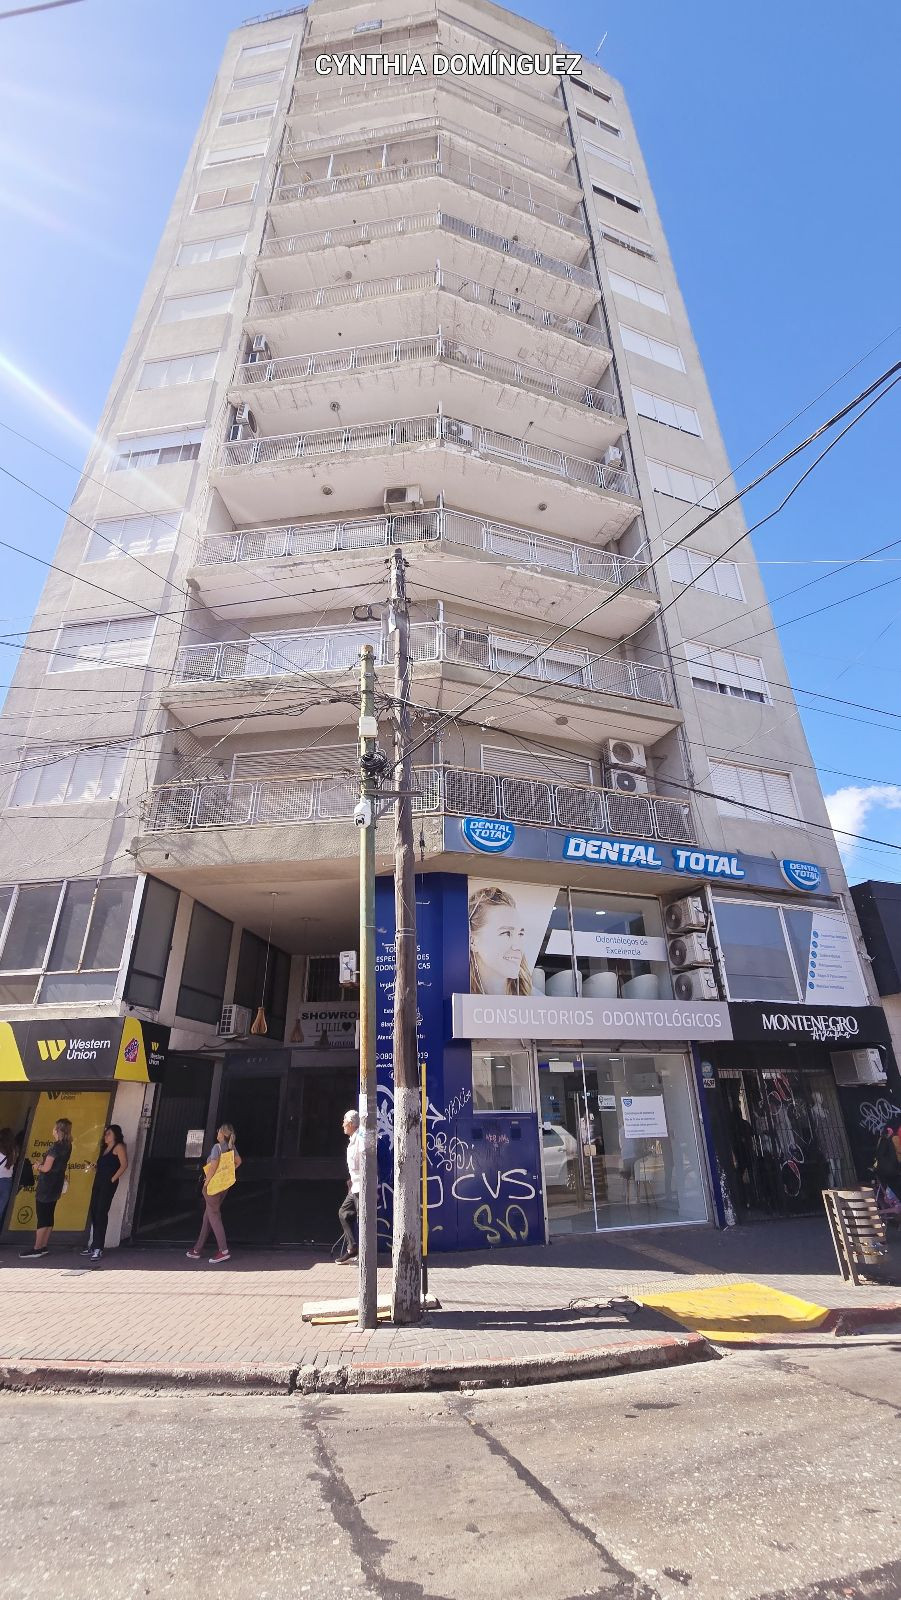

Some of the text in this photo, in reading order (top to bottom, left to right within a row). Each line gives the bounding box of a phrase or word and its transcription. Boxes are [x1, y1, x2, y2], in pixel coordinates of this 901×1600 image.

[470, 821, 512, 834] DENTAL
[475, 829, 508, 840] TOTAL
[566, 836, 745, 876] DENTAL TOTAL
[789, 863, 819, 874] DENTAL
[795, 869, 819, 880] TOTAL
[639, 938, 649, 946] de
[605, 946, 641, 956] Excelencia
[473, 1008, 722, 1028] CONSULTORIOS ODONTOLÓGICOS
[762, 1013, 860, 1035] MONTENEGRO
[69, 1039, 111, 1050] Western
[66, 1049, 97, 1060] Union
